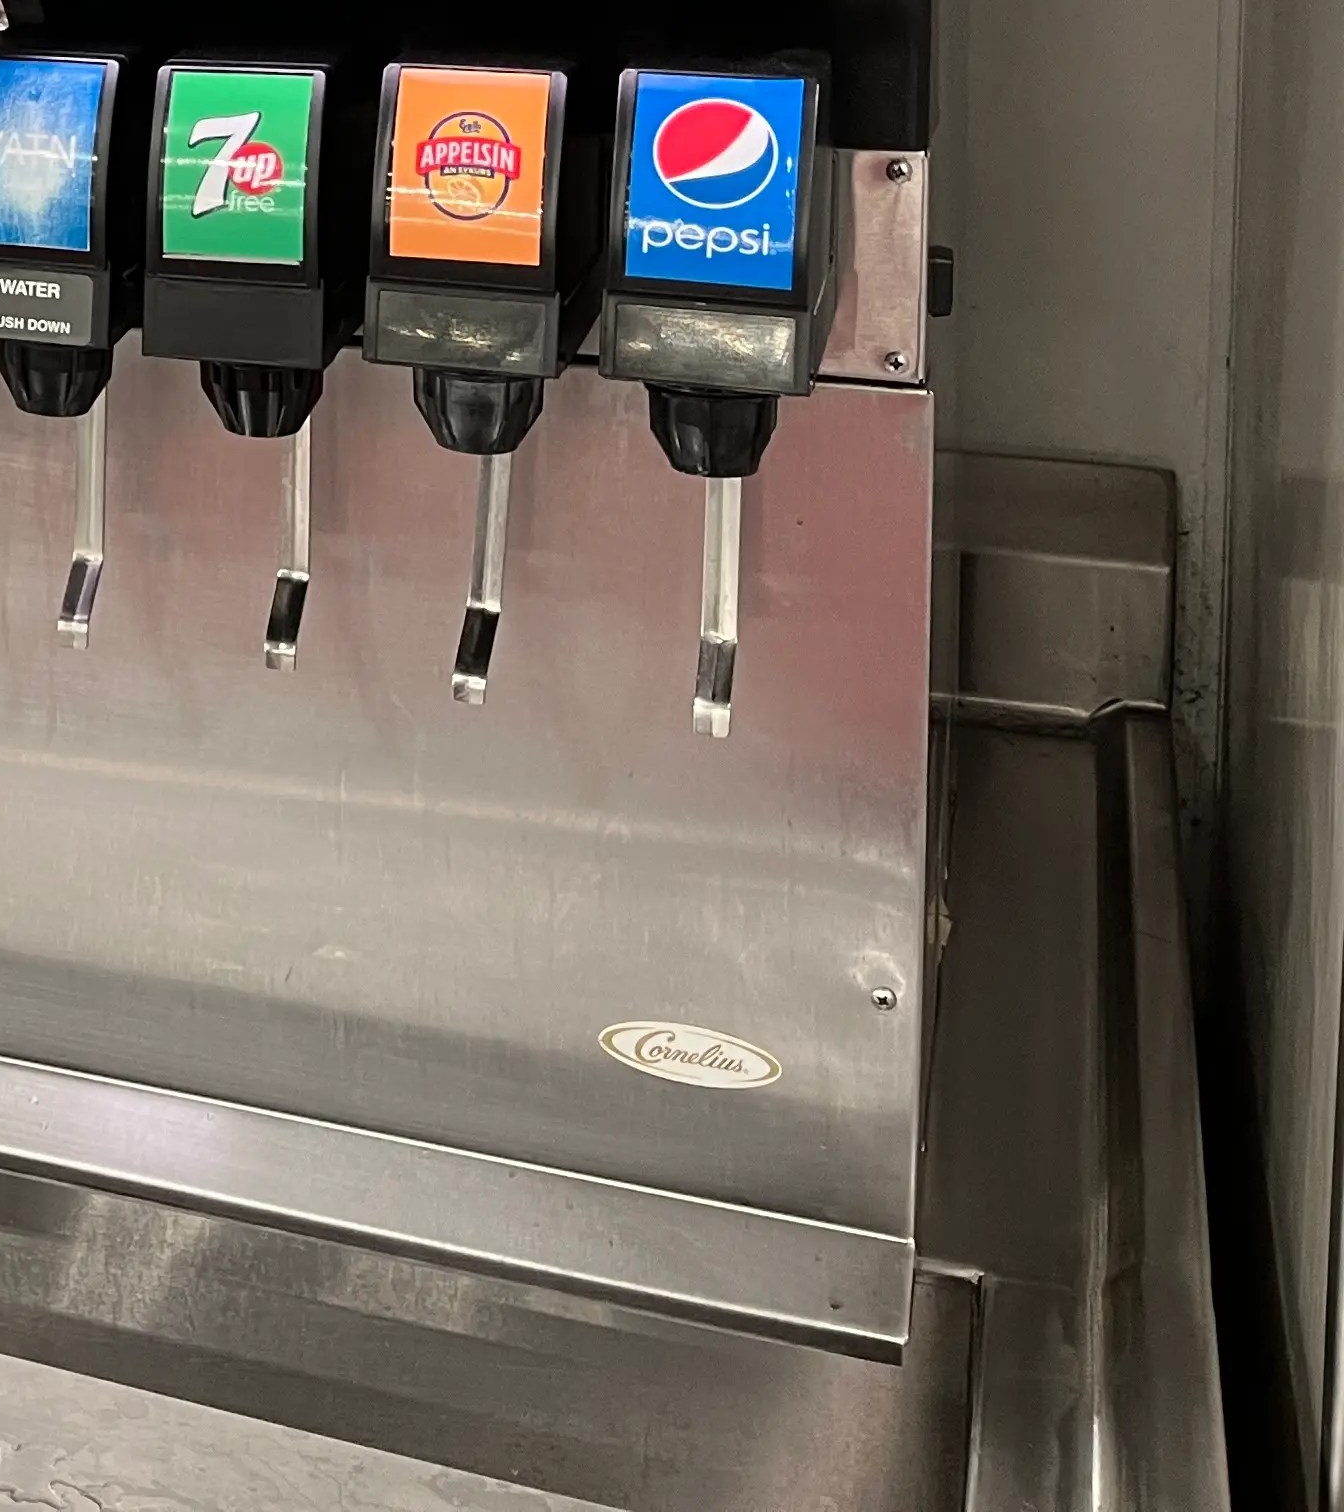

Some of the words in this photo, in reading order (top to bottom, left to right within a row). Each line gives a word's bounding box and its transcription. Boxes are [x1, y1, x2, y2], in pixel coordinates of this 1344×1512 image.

[419, 141, 515, 173] APPELSÍN
[227, 190, 275, 213] free
[641, 222, 770, 258] pepsi
[0, 278, 61, 299] WATER
[27, 317, 72, 335] DOWN
[634, 1030, 744, 1074] Cornelius
